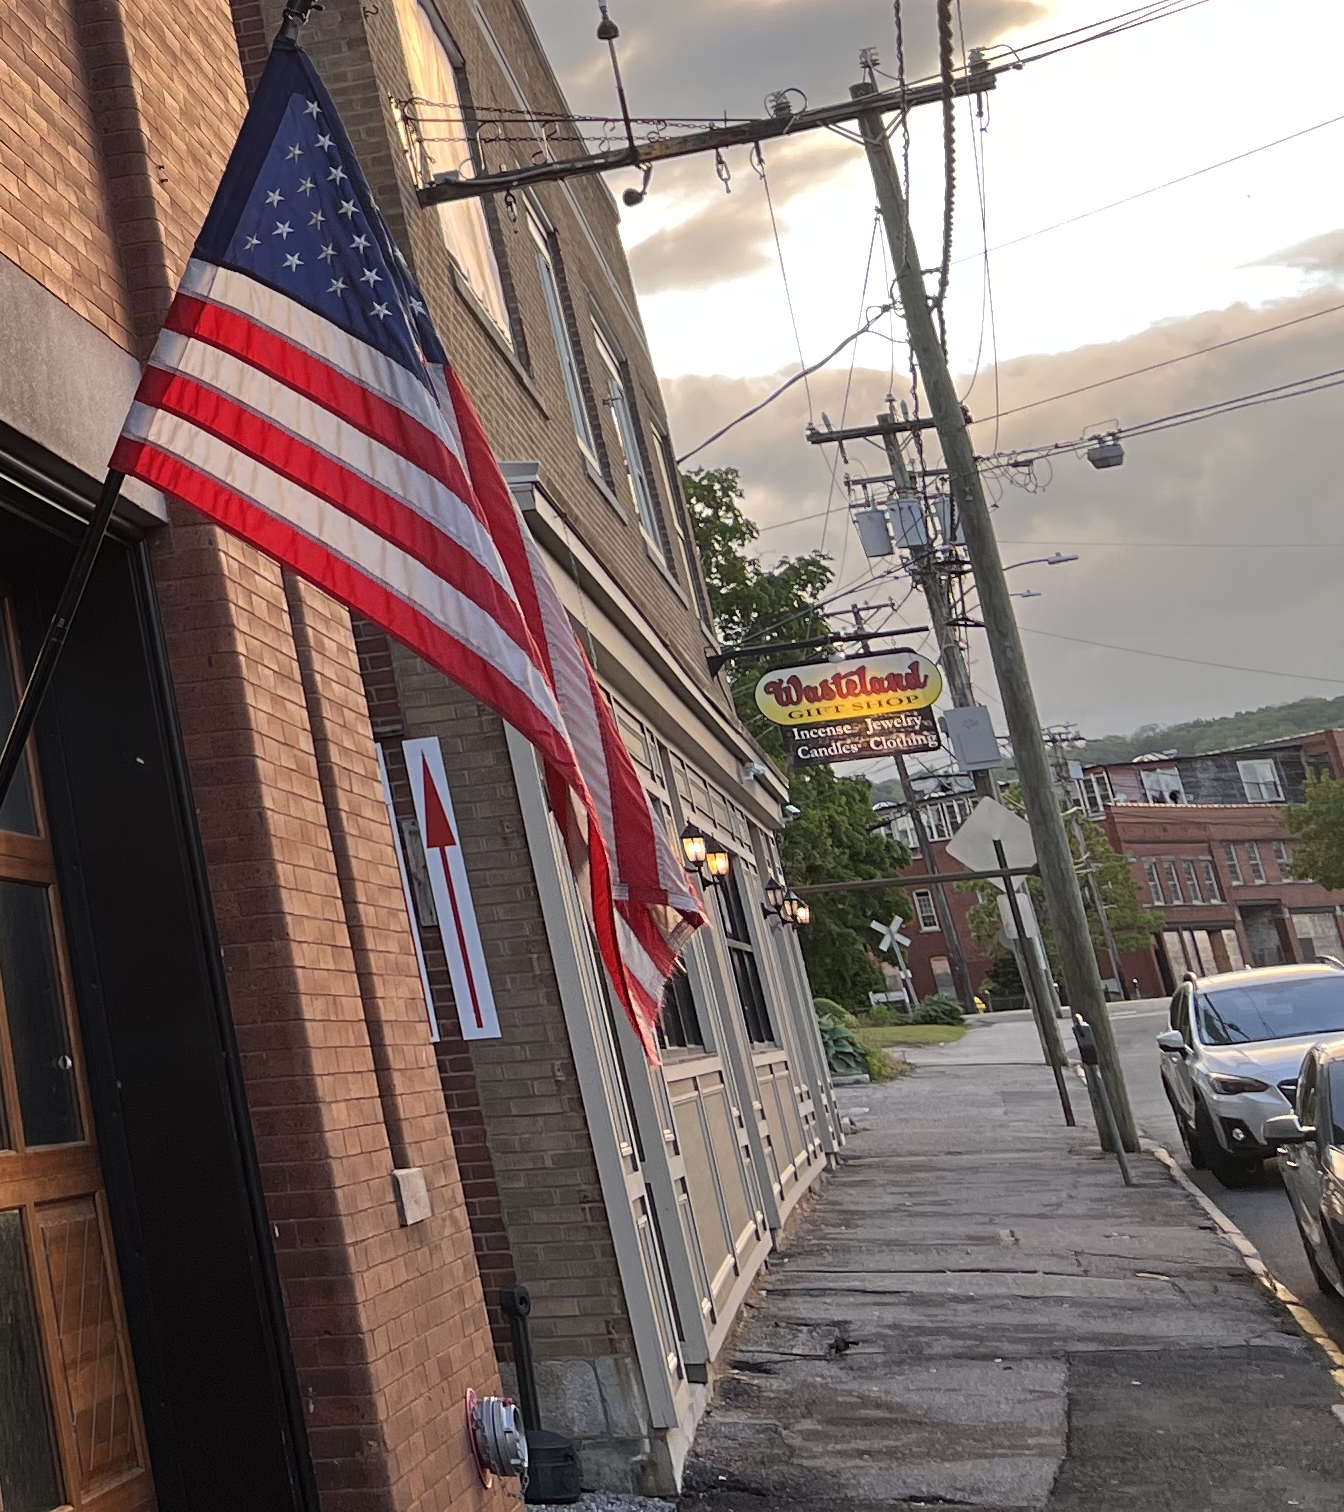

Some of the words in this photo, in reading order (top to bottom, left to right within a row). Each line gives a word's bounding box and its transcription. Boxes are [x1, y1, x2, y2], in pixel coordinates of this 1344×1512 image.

[764, 660, 929, 708] Wasteland
[787, 703, 845, 720] GIFT
[852, 694, 920, 713] SHOP
[791, 722, 853, 741] Incense
[864, 713, 922, 735] Jewelry
[797, 740, 859, 760] Candles
[868, 731, 939, 751] Clothing
